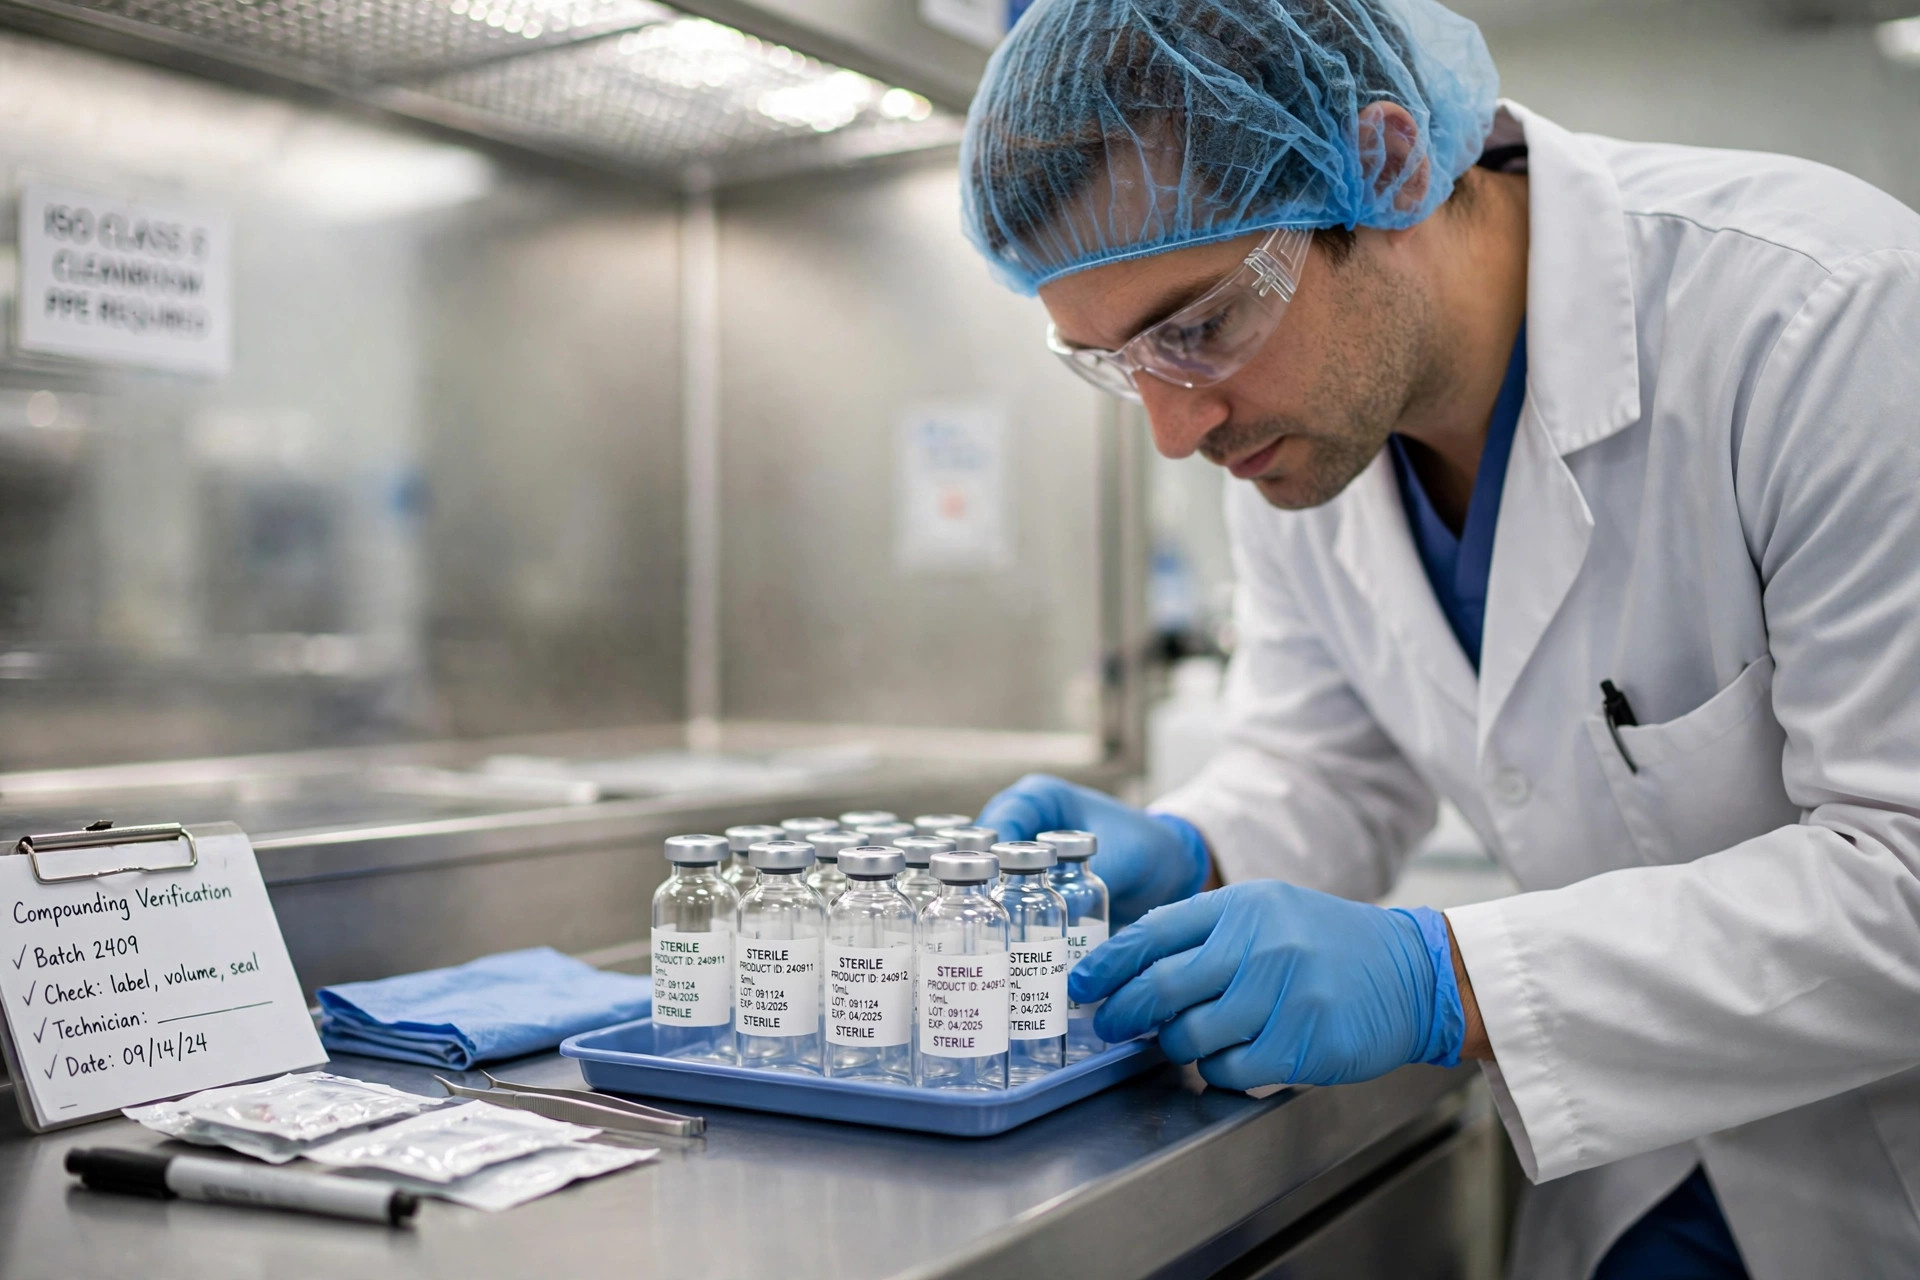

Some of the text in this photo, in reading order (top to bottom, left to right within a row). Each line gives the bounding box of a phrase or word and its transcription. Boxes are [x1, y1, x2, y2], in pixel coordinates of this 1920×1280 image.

[13, 884, 232, 927] Compounding Verification
[34, 935, 139, 968] Batch 2409
[660, 940, 700, 953] STERILE
[697, 955, 725, 966] 240911
[746, 948, 789, 961] STERILE
[1010, 951, 1053, 963] STERILE
[740, 961, 771, 974] PRODUCT
[786, 963, 814, 974] 240911
[839, 957, 883, 969] STERILE
[831, 970, 866, 983] PRODUCT
[881, 970, 909, 983] 240912
[937, 965, 983, 978] STERILE
[44, 952, 260, 1005] Check: label, volume, seal
[927, 979, 966, 992] PRODUCT
[831, 996, 879, 1009] LOT: 091124
[1020, 992, 1049, 1002] 091124
[657, 1005, 692, 1018] STERILE
[948, 1008, 980, 1018] 091124
[1020, 1003, 1052, 1014] 04/2025
[743, 1015, 780, 1028] STERILE
[848, 1011, 882, 1021] 04/2025
[52, 1011, 148, 1040] Technician:
[835, 1025, 875, 1038] STERILE
[947, 1021, 983, 1031] 04/2025
[1010, 1019, 1046, 1031] TERILE
[933, 1035, 975, 1048] STERILE
[66, 1031, 208, 1077] Date: 09/14/24
